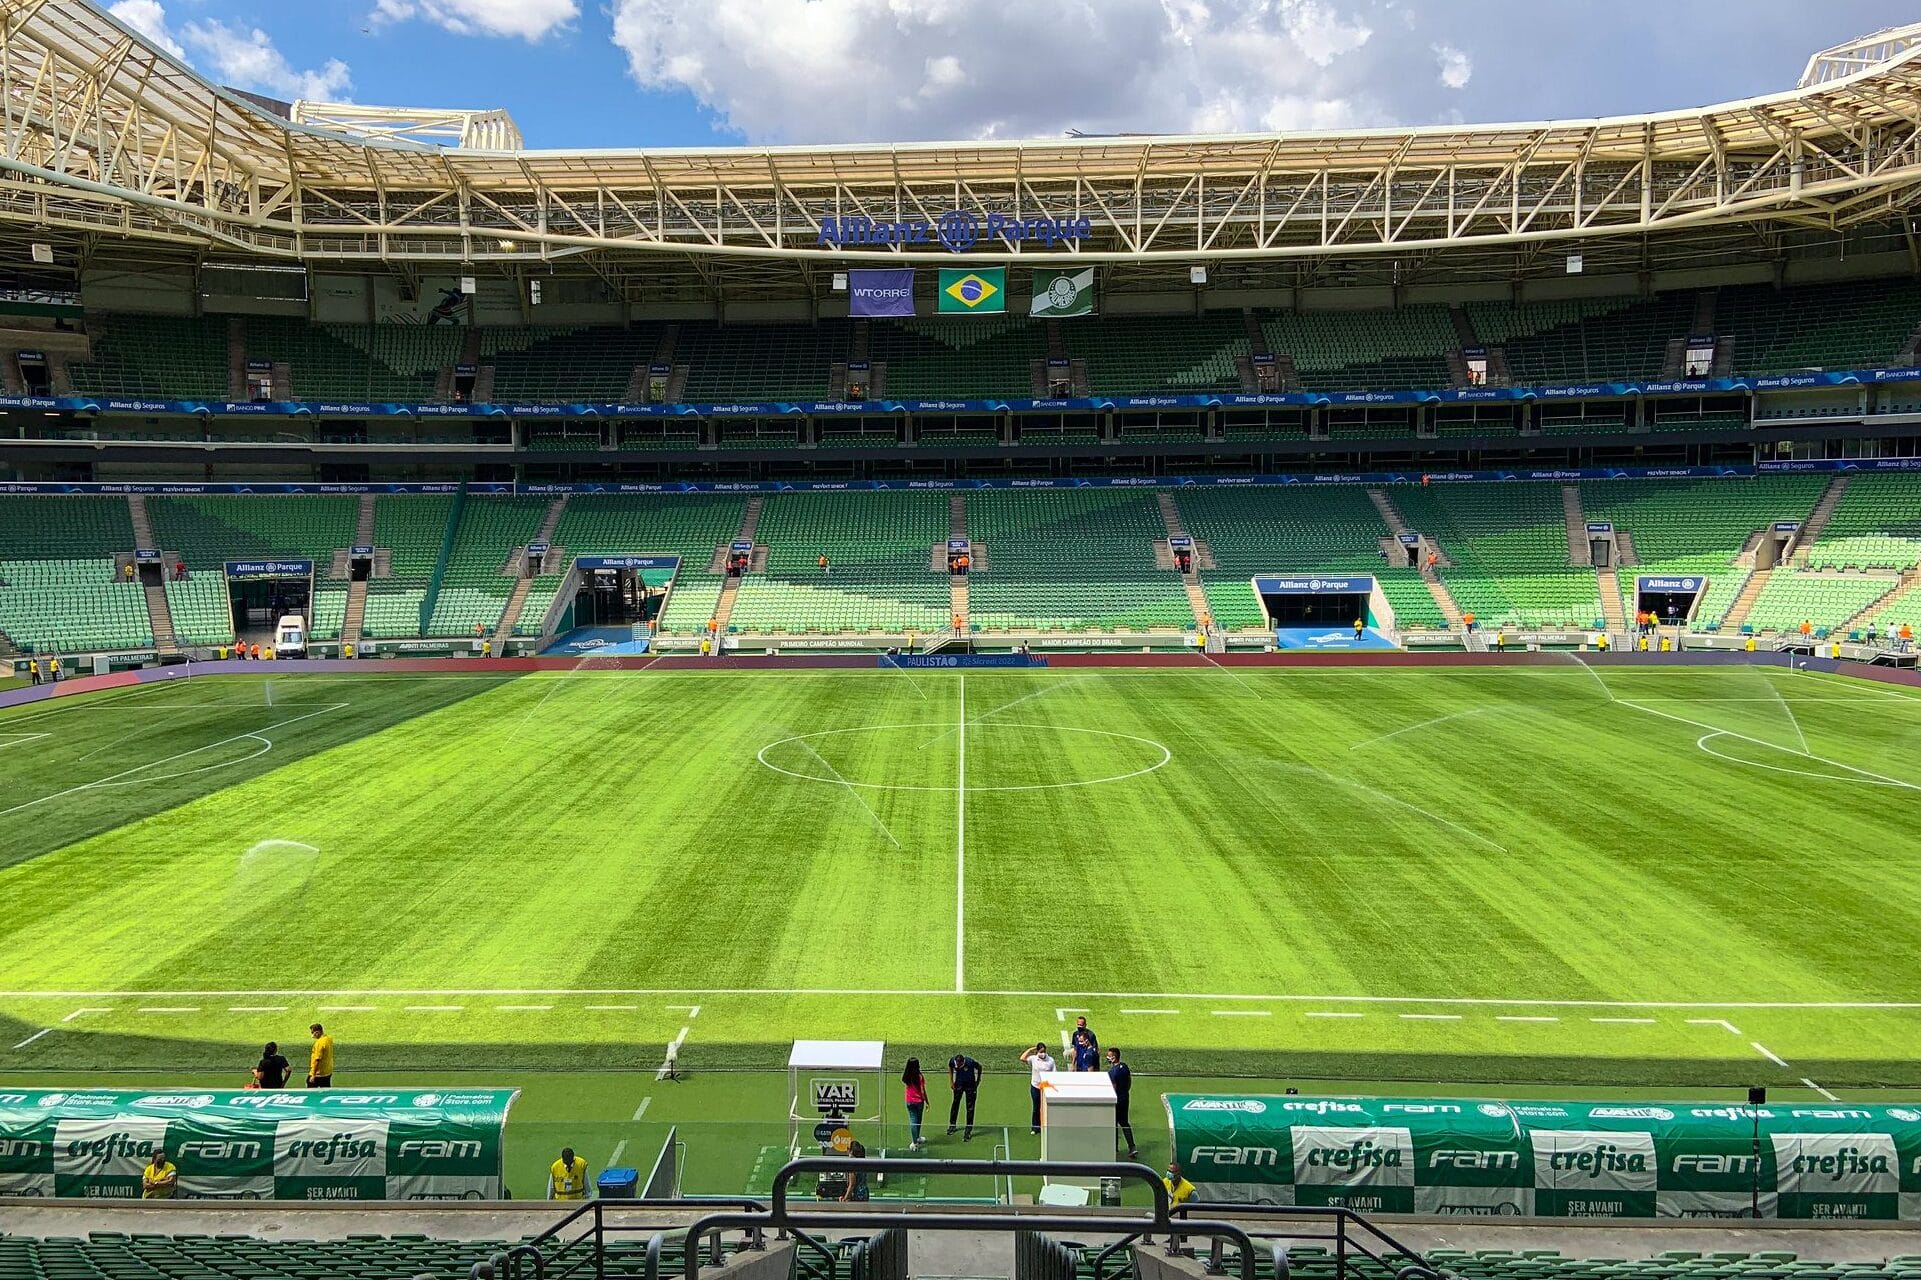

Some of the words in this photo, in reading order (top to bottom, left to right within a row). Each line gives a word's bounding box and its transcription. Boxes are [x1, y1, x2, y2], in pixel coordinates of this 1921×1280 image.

[817, 215, 931, 246] Allianz
[987, 212, 1092, 248] Parque
[1647, 383, 1671, 391] Allianz
[1682, 382, 1706, 392] Parque
[1757, 379, 1781, 387] Allianz
[1790, 376, 1815, 386] Seguros
[1545, 388, 1567, 396] Allianz
[1576, 387, 1599, 395] Seguros
[1157, 398, 1177, 406] Seguros
[1265, 395, 1286, 405] Parque
[1345, 393, 1365, 401] Allianz
[1373, 393, 1394, 402] Seguros
[33, 399, 56, 409] Parque
[110, 401, 132, 409] Allianz
[142, 402, 166, 411] Seguros
[349, 405, 370, 413] Seguros
[448, 405, 468, 414] Parque
[843, 404, 863, 412] Parque
[236, 564, 265, 572] Allianz
[277, 563, 303, 572] Parque
[1279, 581, 1309, 589] Allianz
[1322, 581, 1349, 590] Parque
[1648, 580, 1681, 588] Allianz
[119, 654, 154, 662] PALMEIRAS
[998, 657, 1016, 665] 2022
[815, 1082, 855, 1098] VAR
[229, 1092, 308, 1108] crefisa
[1282, 1100, 1363, 1115] crefisa
[1691, 1107, 1776, 1121] crefisa
[67, 1132, 153, 1164] crefisa
[287, 1132, 376, 1165] crefisa
[1308, 1141, 1402, 1174] crefisa
[1550, 1145, 1646, 1179] crefisa
[1793, 1147, 1888, 1181] crefisa
[83, 1186, 100, 1197] SER
[102, 1186, 133, 1197] AVANTI
[307, 1187, 325, 1198] SER
[326, 1187, 358, 1198] AVANTI
[1348, 1197, 1382, 1209] AVANTI
[1568, 1201, 1585, 1212] SER
[1588, 1201, 1623, 1212] AVANTI
[1812, 1203, 1830, 1215] SER
[1832, 1203, 1867, 1215] AVANTI
